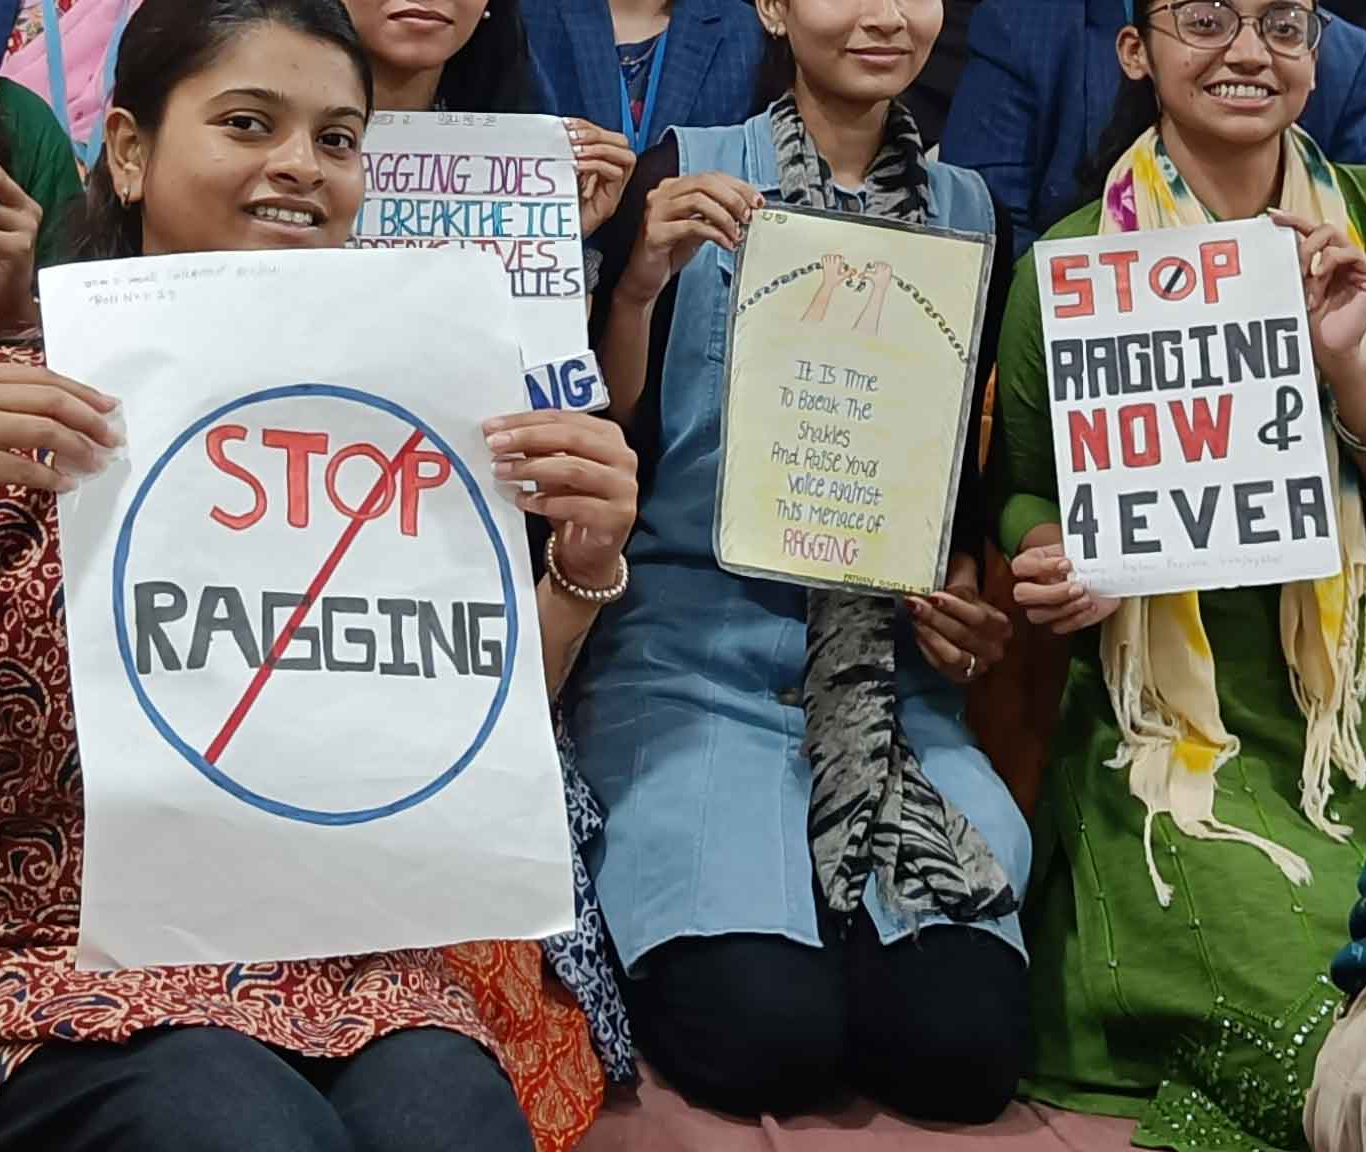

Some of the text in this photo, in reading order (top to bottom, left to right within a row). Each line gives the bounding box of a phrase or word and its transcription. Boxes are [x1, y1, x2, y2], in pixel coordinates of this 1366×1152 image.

[483, 155, 556, 197] DOES
[1049, 240, 1242, 318] STOP
[1051, 317, 1301, 402] RAGGING
[1067, 385, 1304, 473] NOW &
[206, 425, 453, 537] STOP
[783, 527, 860, 566] RAGGING
[134, 582, 506, 679] RAGGING
